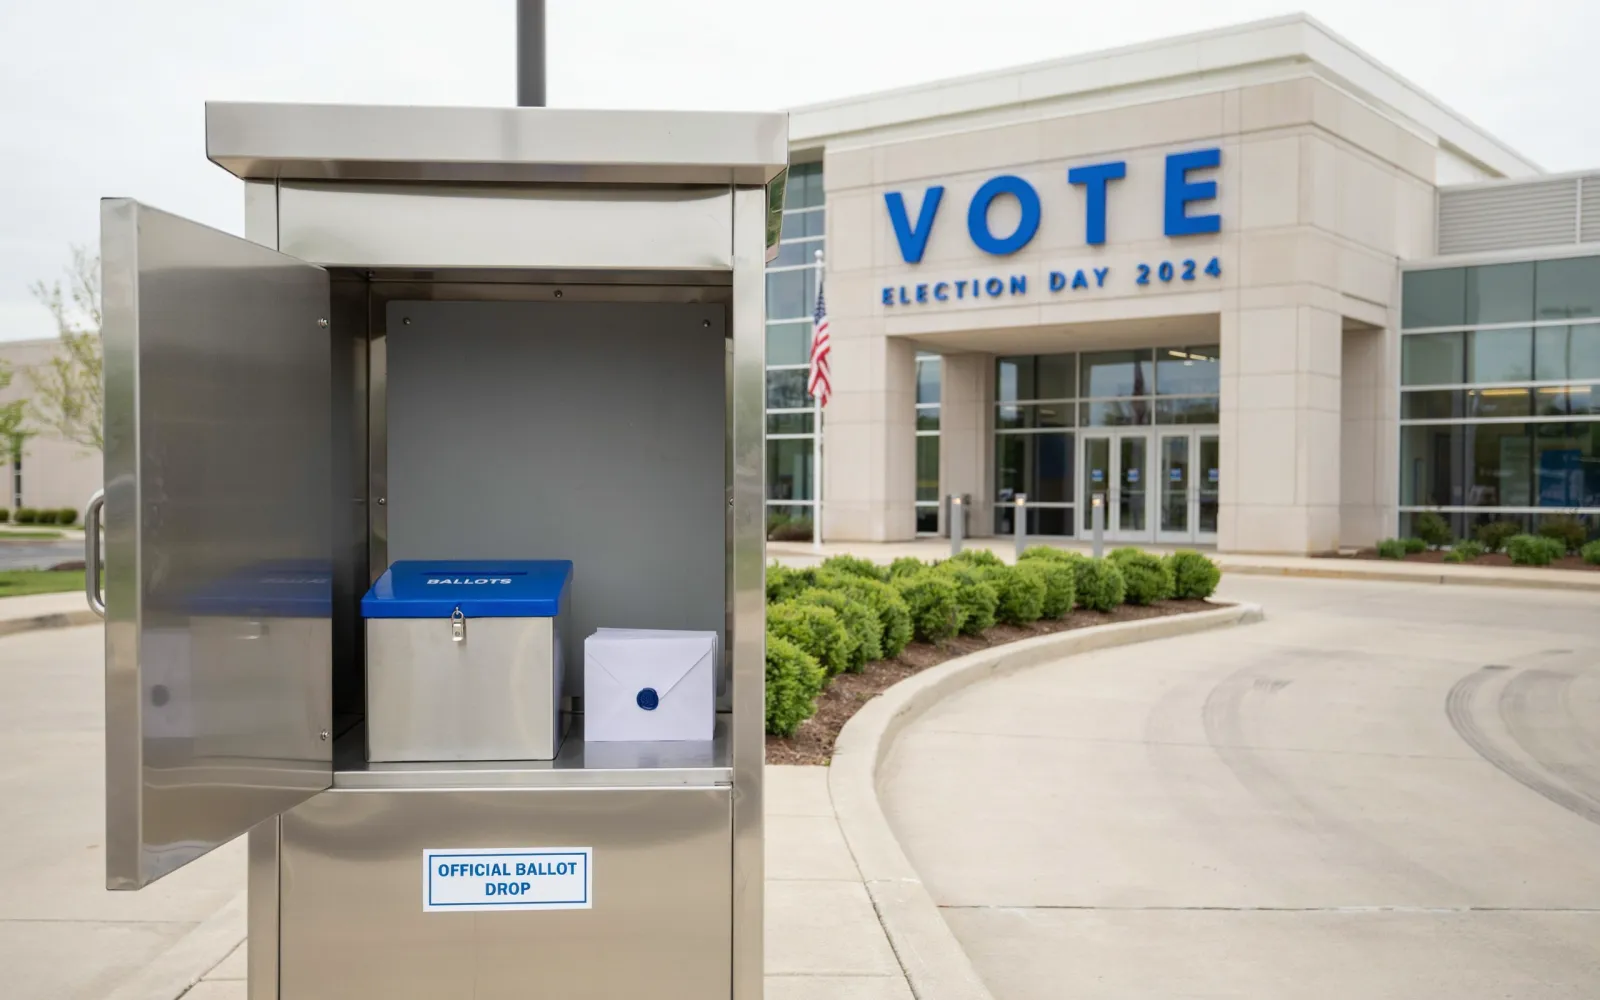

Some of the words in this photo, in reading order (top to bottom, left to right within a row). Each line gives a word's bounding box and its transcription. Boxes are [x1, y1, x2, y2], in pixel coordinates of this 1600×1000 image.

[883, 147, 1222, 264] VOTE
[881, 274, 1028, 305] ELECTION
[1048, 267, 1110, 293] DAY
[1135, 256, 1222, 285] 2024
[437, 862, 511, 878] OFFICIAL
[515, 861, 577, 877] BALLOT
[484, 881, 531, 897] DROP
